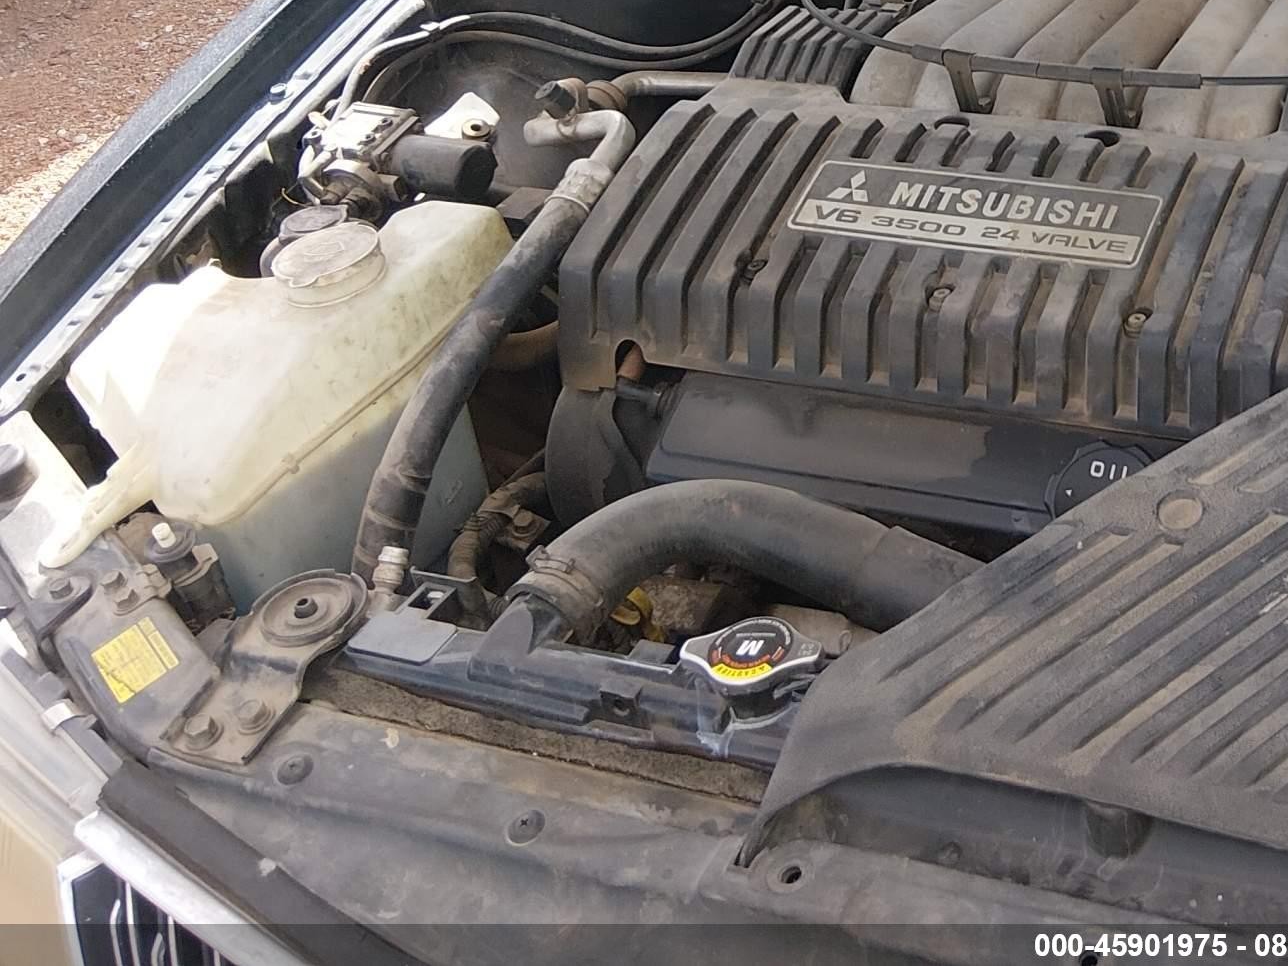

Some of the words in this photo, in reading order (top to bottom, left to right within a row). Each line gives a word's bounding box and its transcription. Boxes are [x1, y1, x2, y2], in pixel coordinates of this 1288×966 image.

[815, 204, 861, 224] V6
[872, 214, 966, 237] 3500
[980, 227, 1019, 242] 24
[1031, 230, 1129, 253] VALVE
[888, 181, 1119, 230] MITSUBISHI
